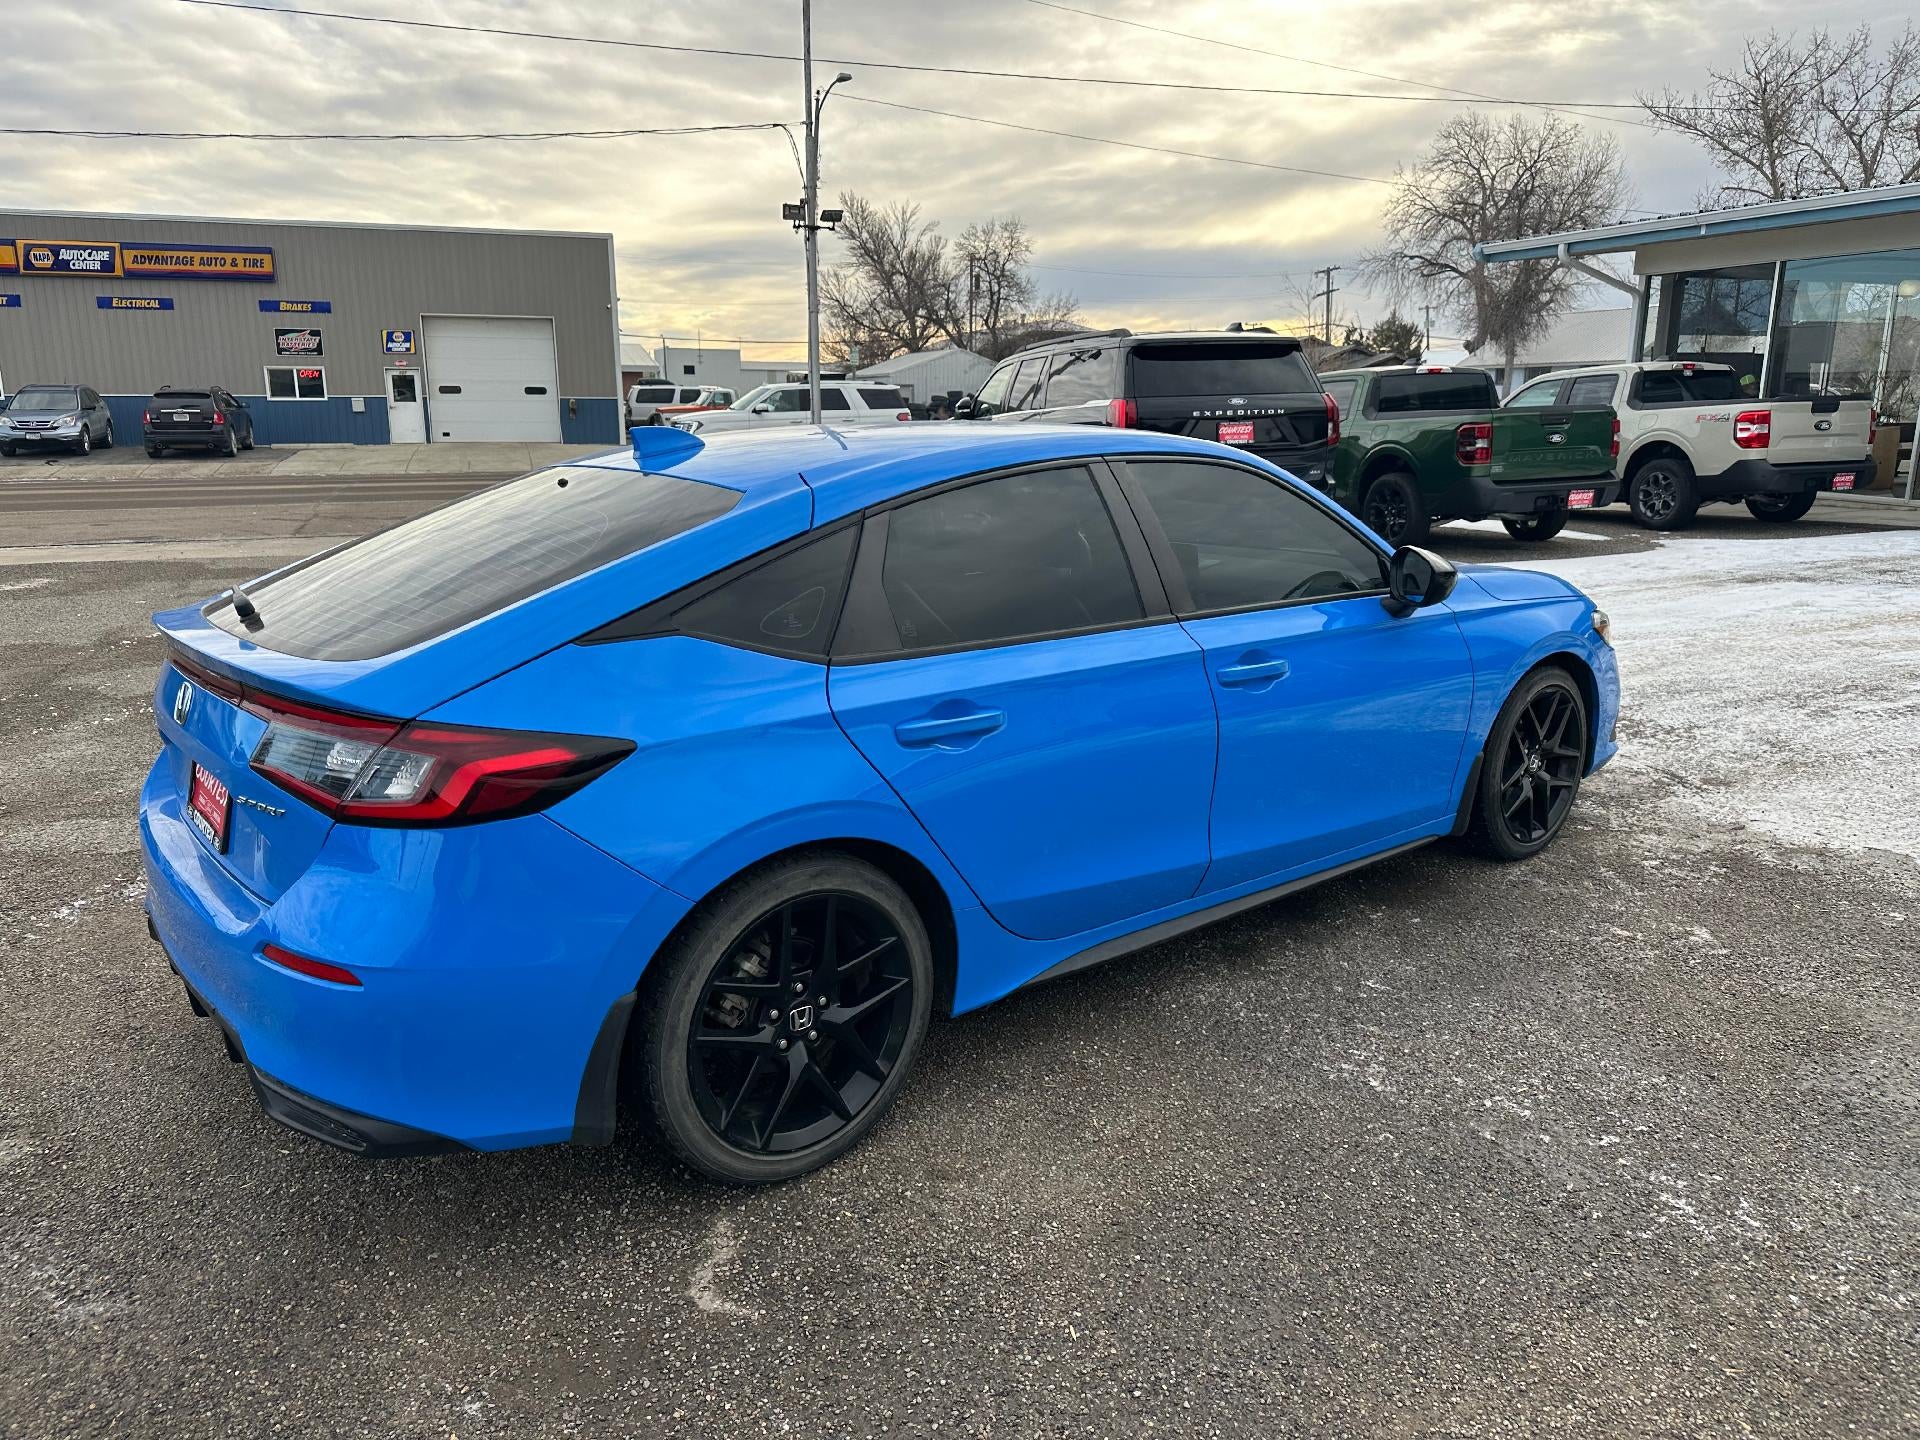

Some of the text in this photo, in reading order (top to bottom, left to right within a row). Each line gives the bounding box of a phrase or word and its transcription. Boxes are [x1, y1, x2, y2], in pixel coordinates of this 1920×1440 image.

[33, 252, 51, 262] NAPA
[132, 254, 265, 268] ADVANTAGE AUTO & TIRE
[70, 260, 101, 270] CENTER
[112, 298, 160, 308] ELECTRICAL
[280, 301, 312, 311] BRAKES
[299, 369, 320, 378] OPEN
[1193, 409, 1285, 417] EXPEDITION
[1219, 425, 1254, 434] COURTESY
[1509, 450, 1595, 462] MAVERICK
[237, 795, 287, 817] SPORT
